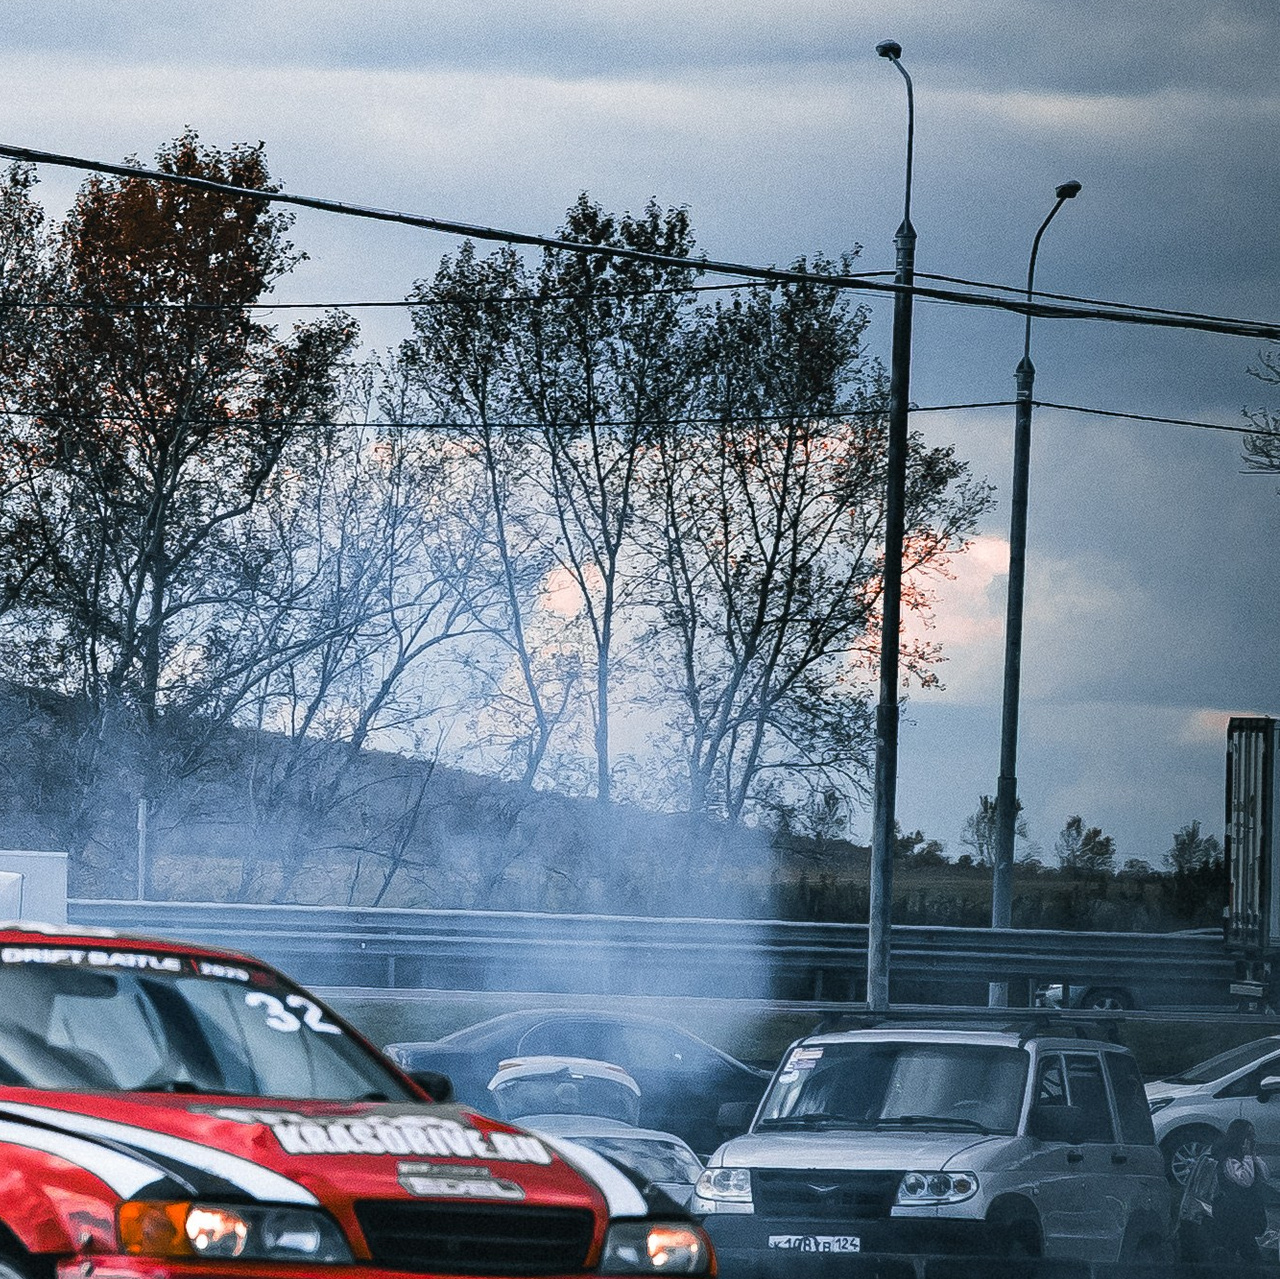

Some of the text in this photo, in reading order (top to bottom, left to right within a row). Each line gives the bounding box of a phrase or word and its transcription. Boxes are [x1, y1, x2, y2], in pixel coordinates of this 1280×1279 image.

[0, 947, 87, 965] DRIFT
[245, 991, 343, 1034] 32
[835, 1237, 860, 1252] 124
